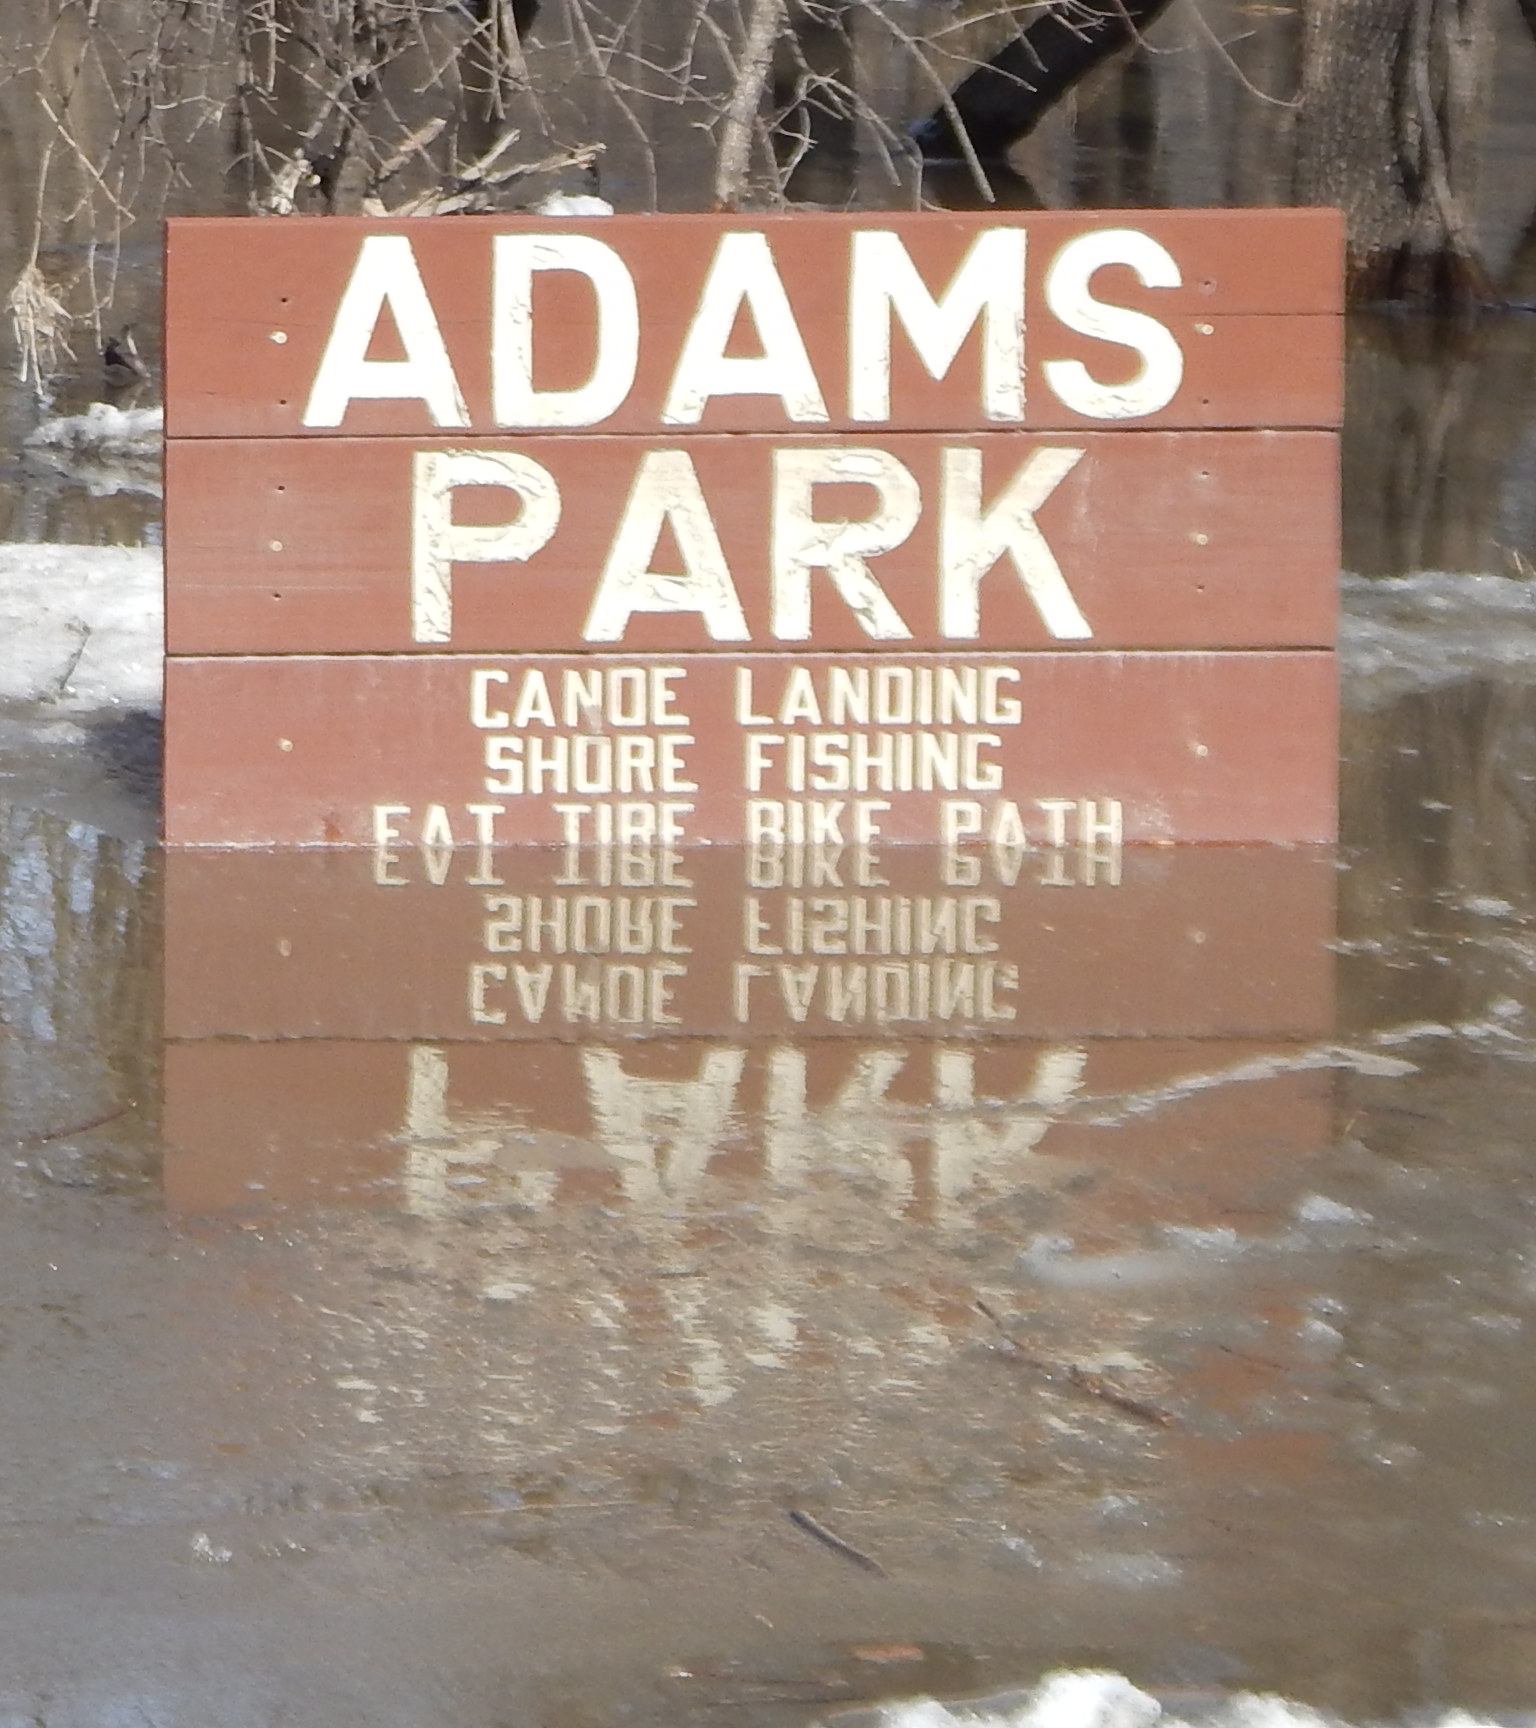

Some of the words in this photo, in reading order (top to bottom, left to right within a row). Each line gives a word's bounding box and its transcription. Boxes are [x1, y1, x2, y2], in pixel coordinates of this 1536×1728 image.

[301, 227, 1184, 427] ADAMS
[410, 444, 1094, 643] PARK
[469, 665, 690, 728] CANOE
[734, 664, 1022, 726] LANDING
[483, 733, 699, 794] SHORE
[744, 731, 1004, 792] FISHING
[552, 802, 696, 845] TIRE
[744, 798, 891, 845] BIKE
[938, 796, 1123, 845] PATH
